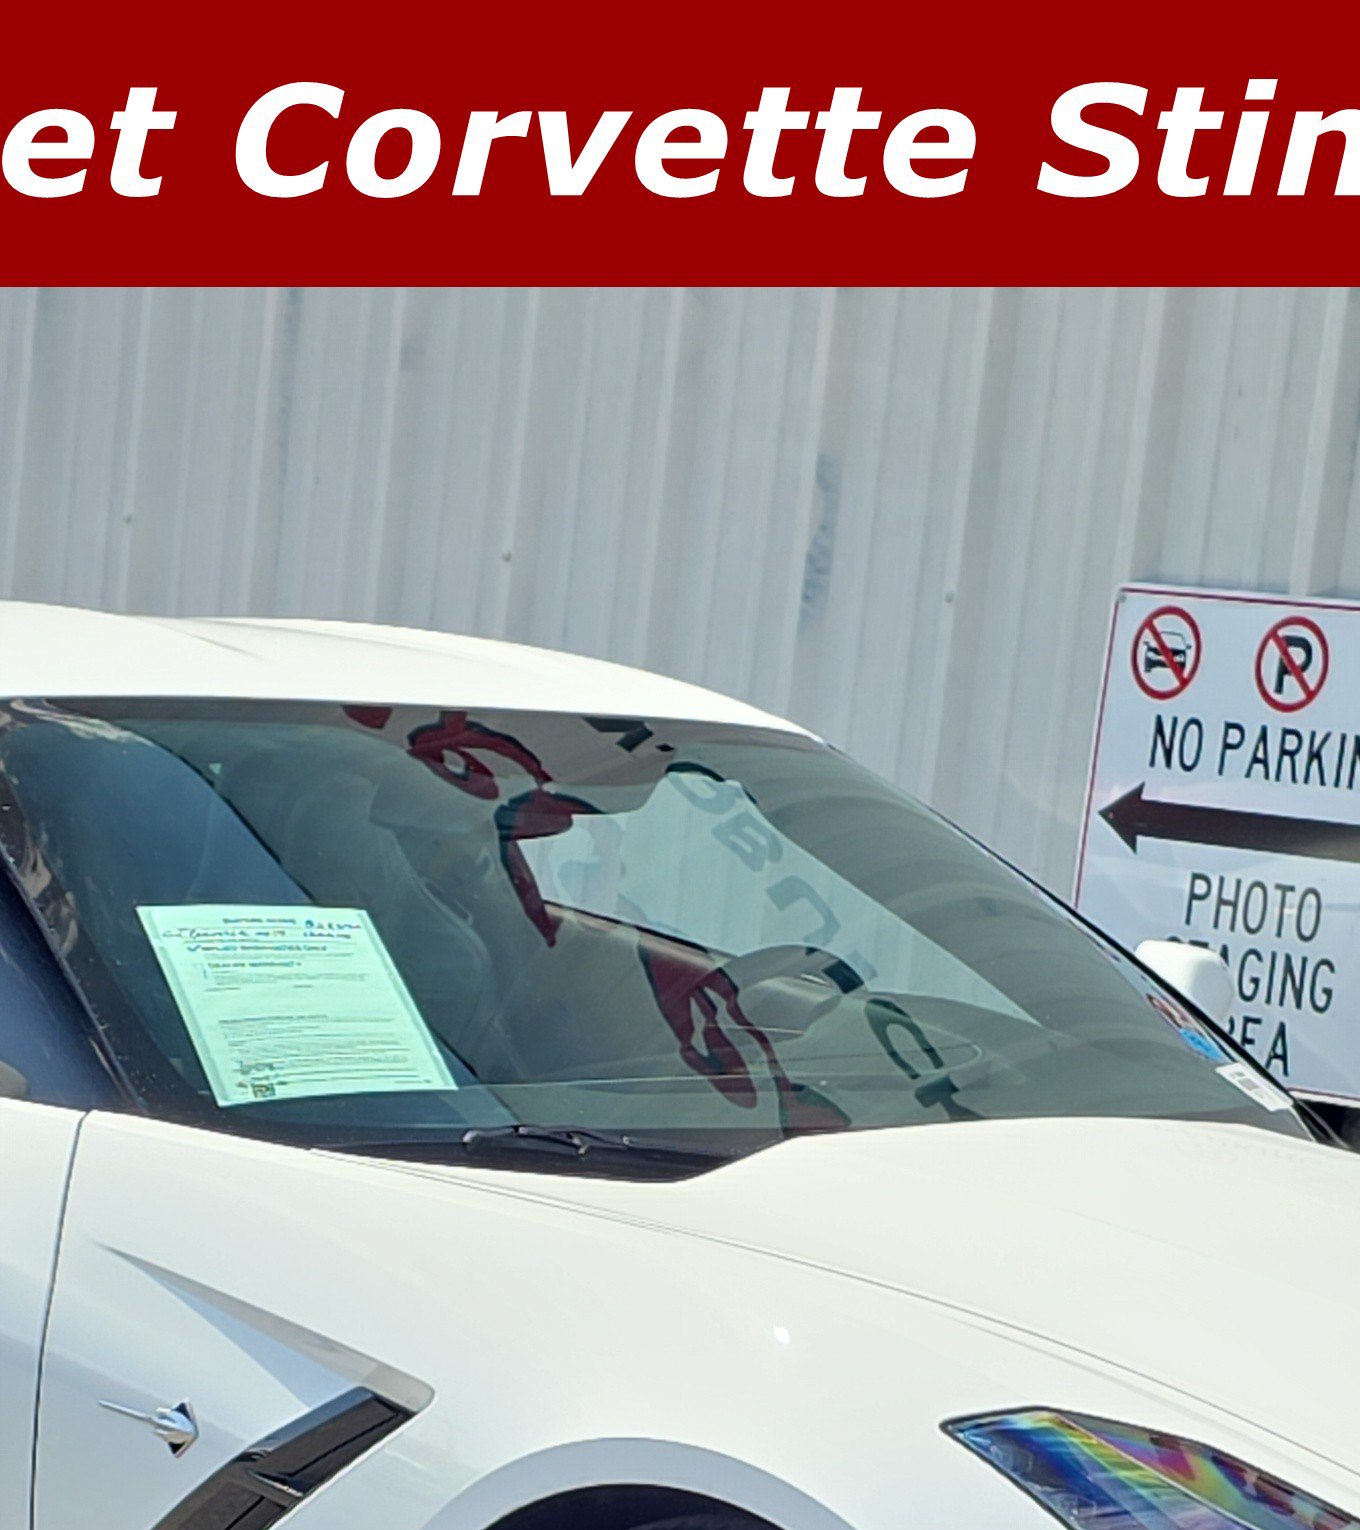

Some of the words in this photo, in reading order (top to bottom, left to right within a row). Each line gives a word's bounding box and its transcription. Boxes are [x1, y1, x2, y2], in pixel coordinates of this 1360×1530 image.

[1274, 635, 1312, 694] P
[1148, 714, 1205, 772] NO
[1184, 872, 1323, 942] PHOTO
[1165, 934, 1337, 1015] GING
